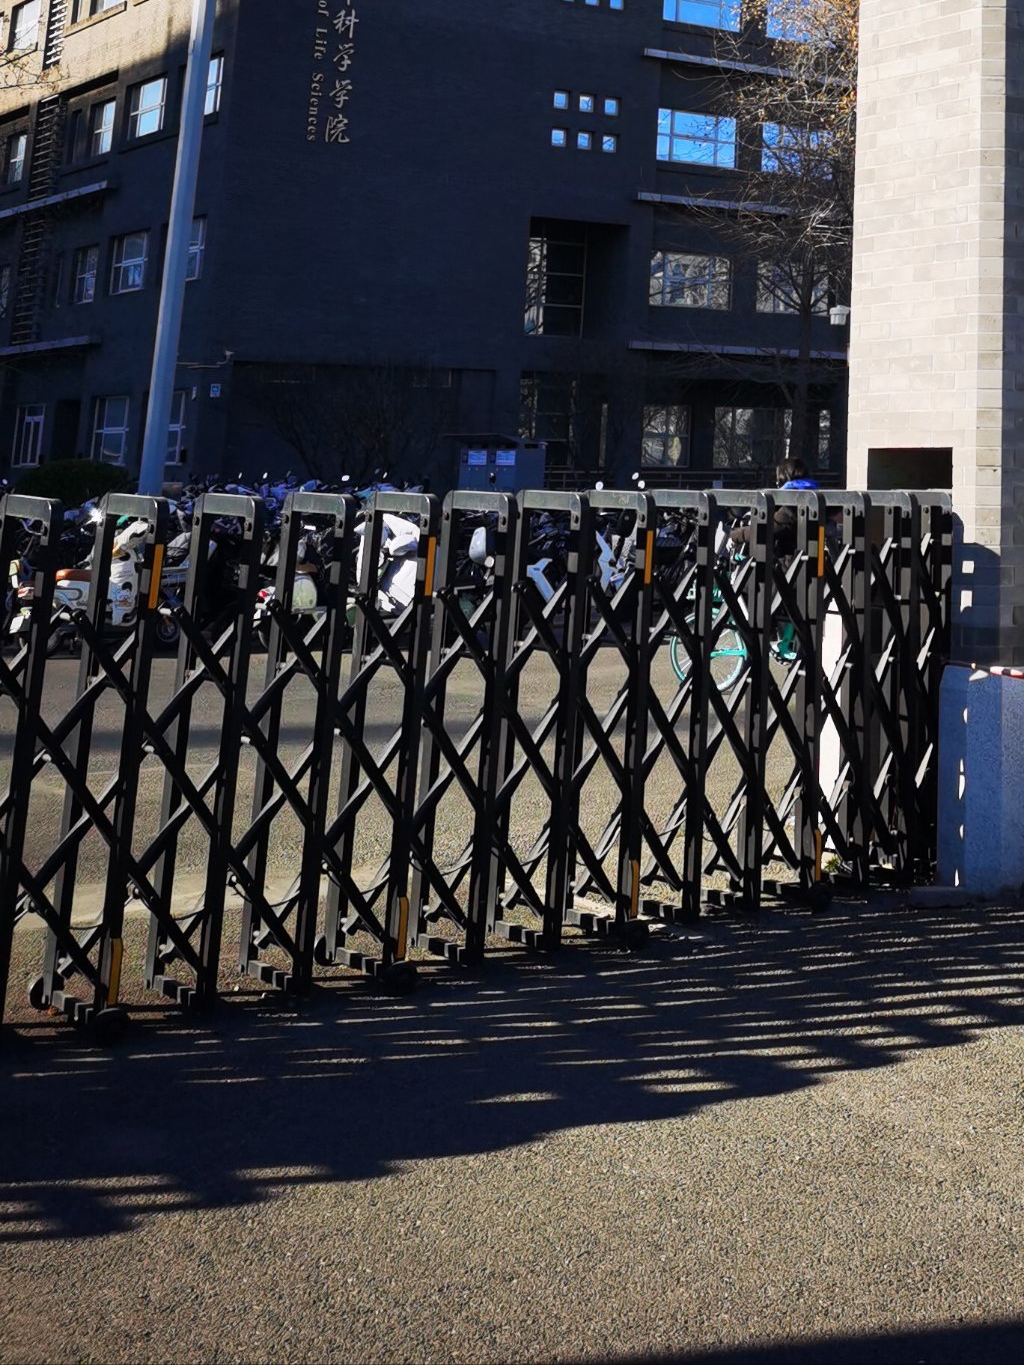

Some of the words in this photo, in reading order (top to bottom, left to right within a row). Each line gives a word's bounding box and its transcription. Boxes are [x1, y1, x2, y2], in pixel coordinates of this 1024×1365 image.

[317, 0, 330, 17] of
[315, 28, 328, 60] Life
[306, 72, 325, 142] Sciences
